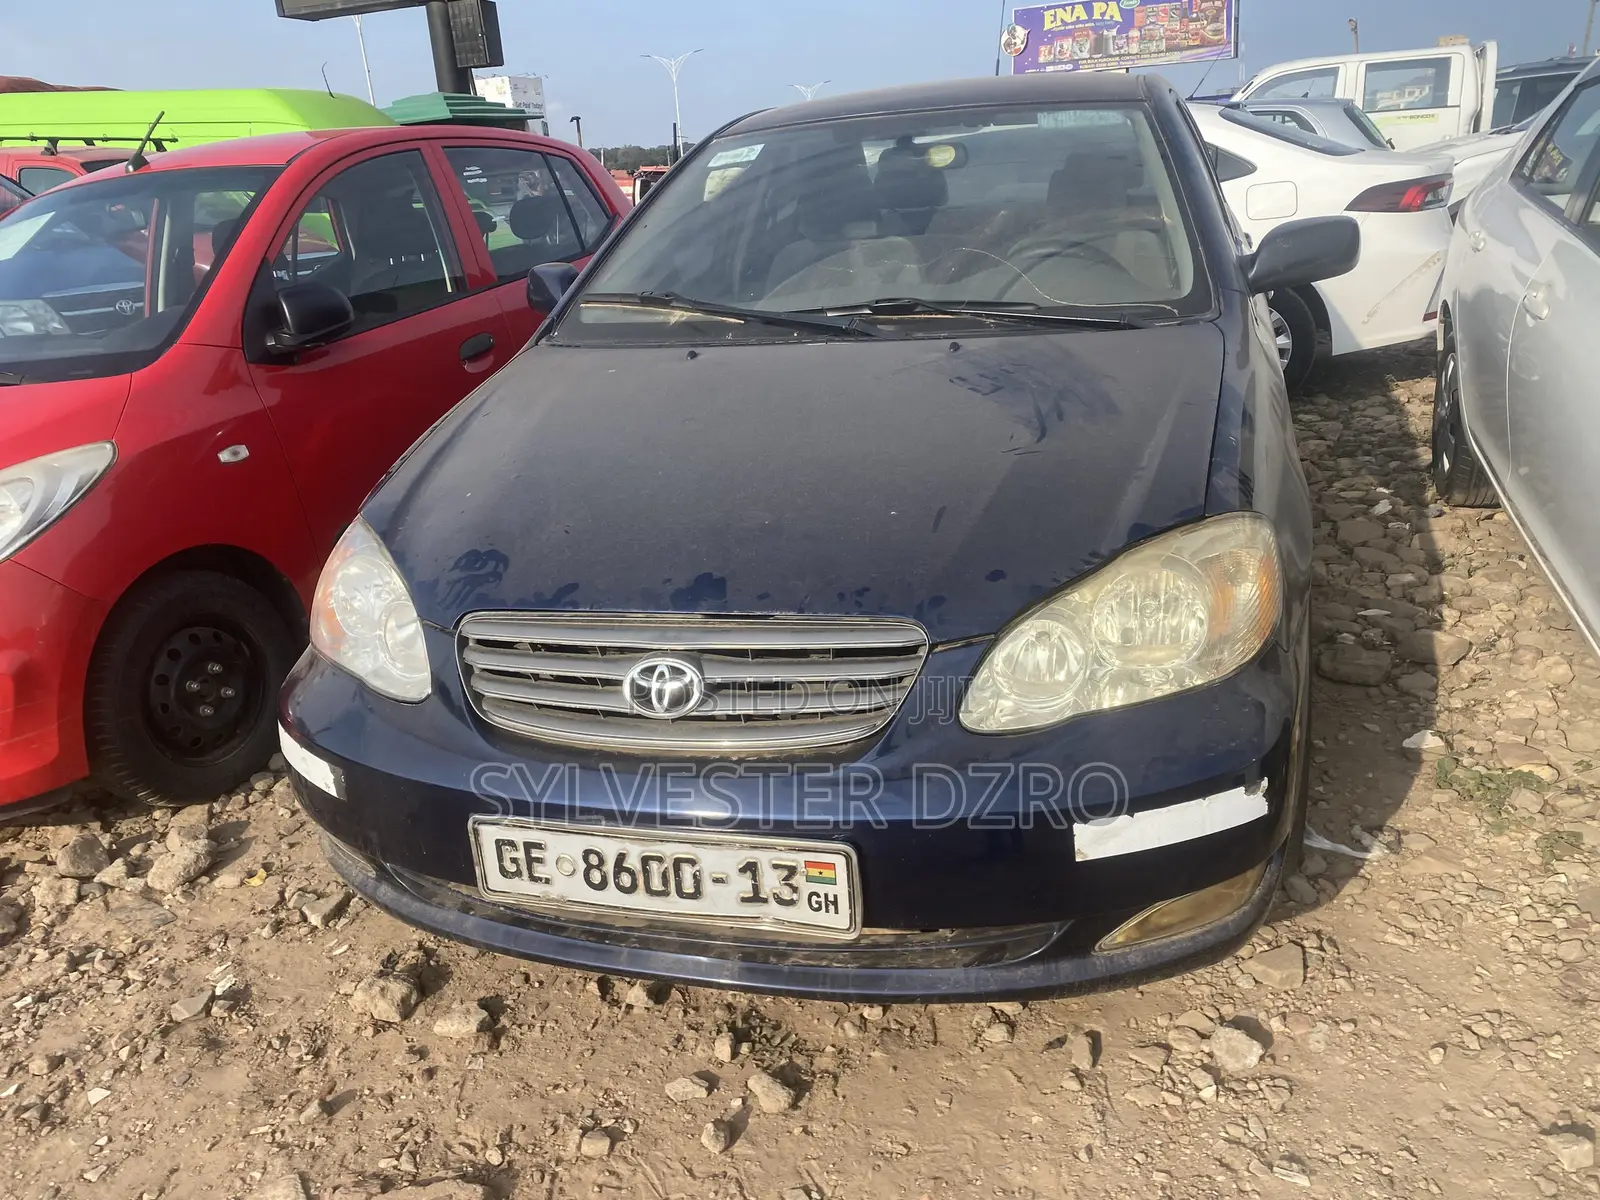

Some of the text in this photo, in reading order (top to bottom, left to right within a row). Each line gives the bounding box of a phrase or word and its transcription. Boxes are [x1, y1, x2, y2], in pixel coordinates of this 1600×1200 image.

[1043, 5, 1088, 31] ENA
[1092, 1, 1123, 22] PA
[523, 101, 531, 109] Paid
[494, 837, 552, 885] GE
[807, 890, 840, 915] GH
